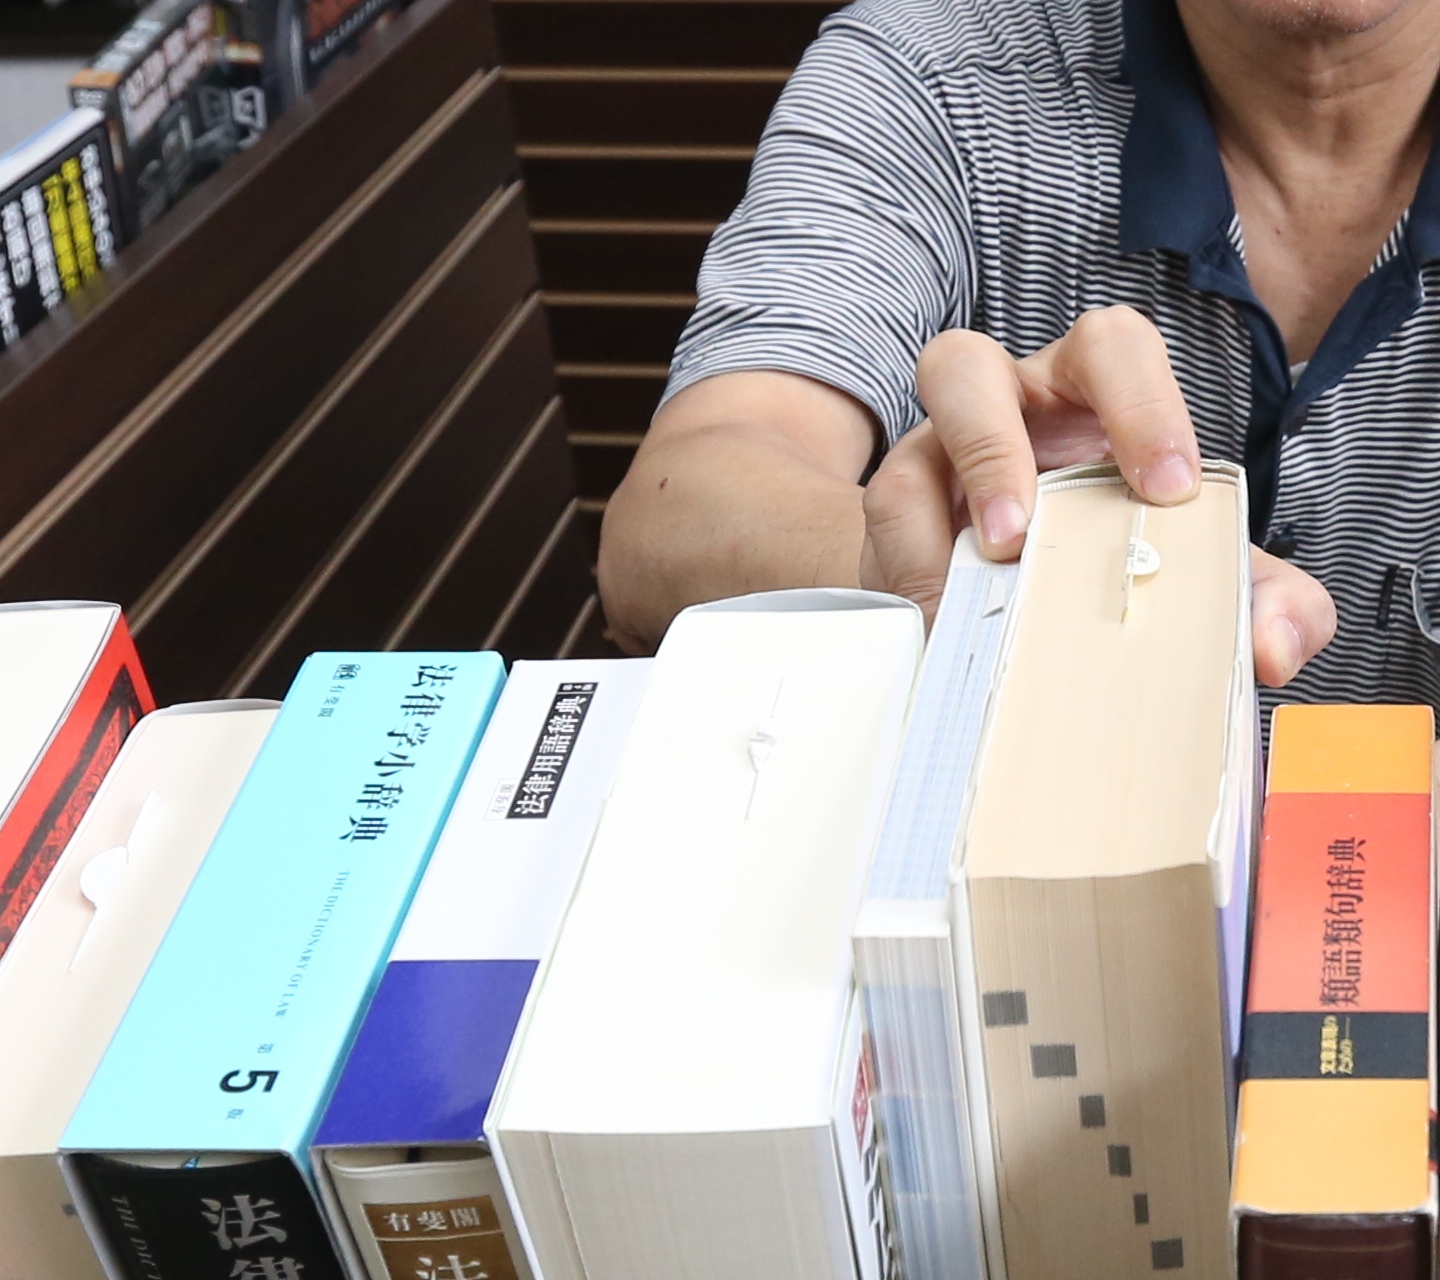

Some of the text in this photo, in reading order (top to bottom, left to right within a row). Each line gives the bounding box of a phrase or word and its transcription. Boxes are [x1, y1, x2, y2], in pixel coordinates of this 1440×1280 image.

[338, 664, 459, 843] 法律学小辞典
[513, 694, 588, 817] 法律用語辞典
[274, 870, 350, 1020] THE DICTIONARY OF LAW
[1318, 836, 1367, 1007] 類語類句辞典
[383, 1207, 482, 1233] 有斐閣
